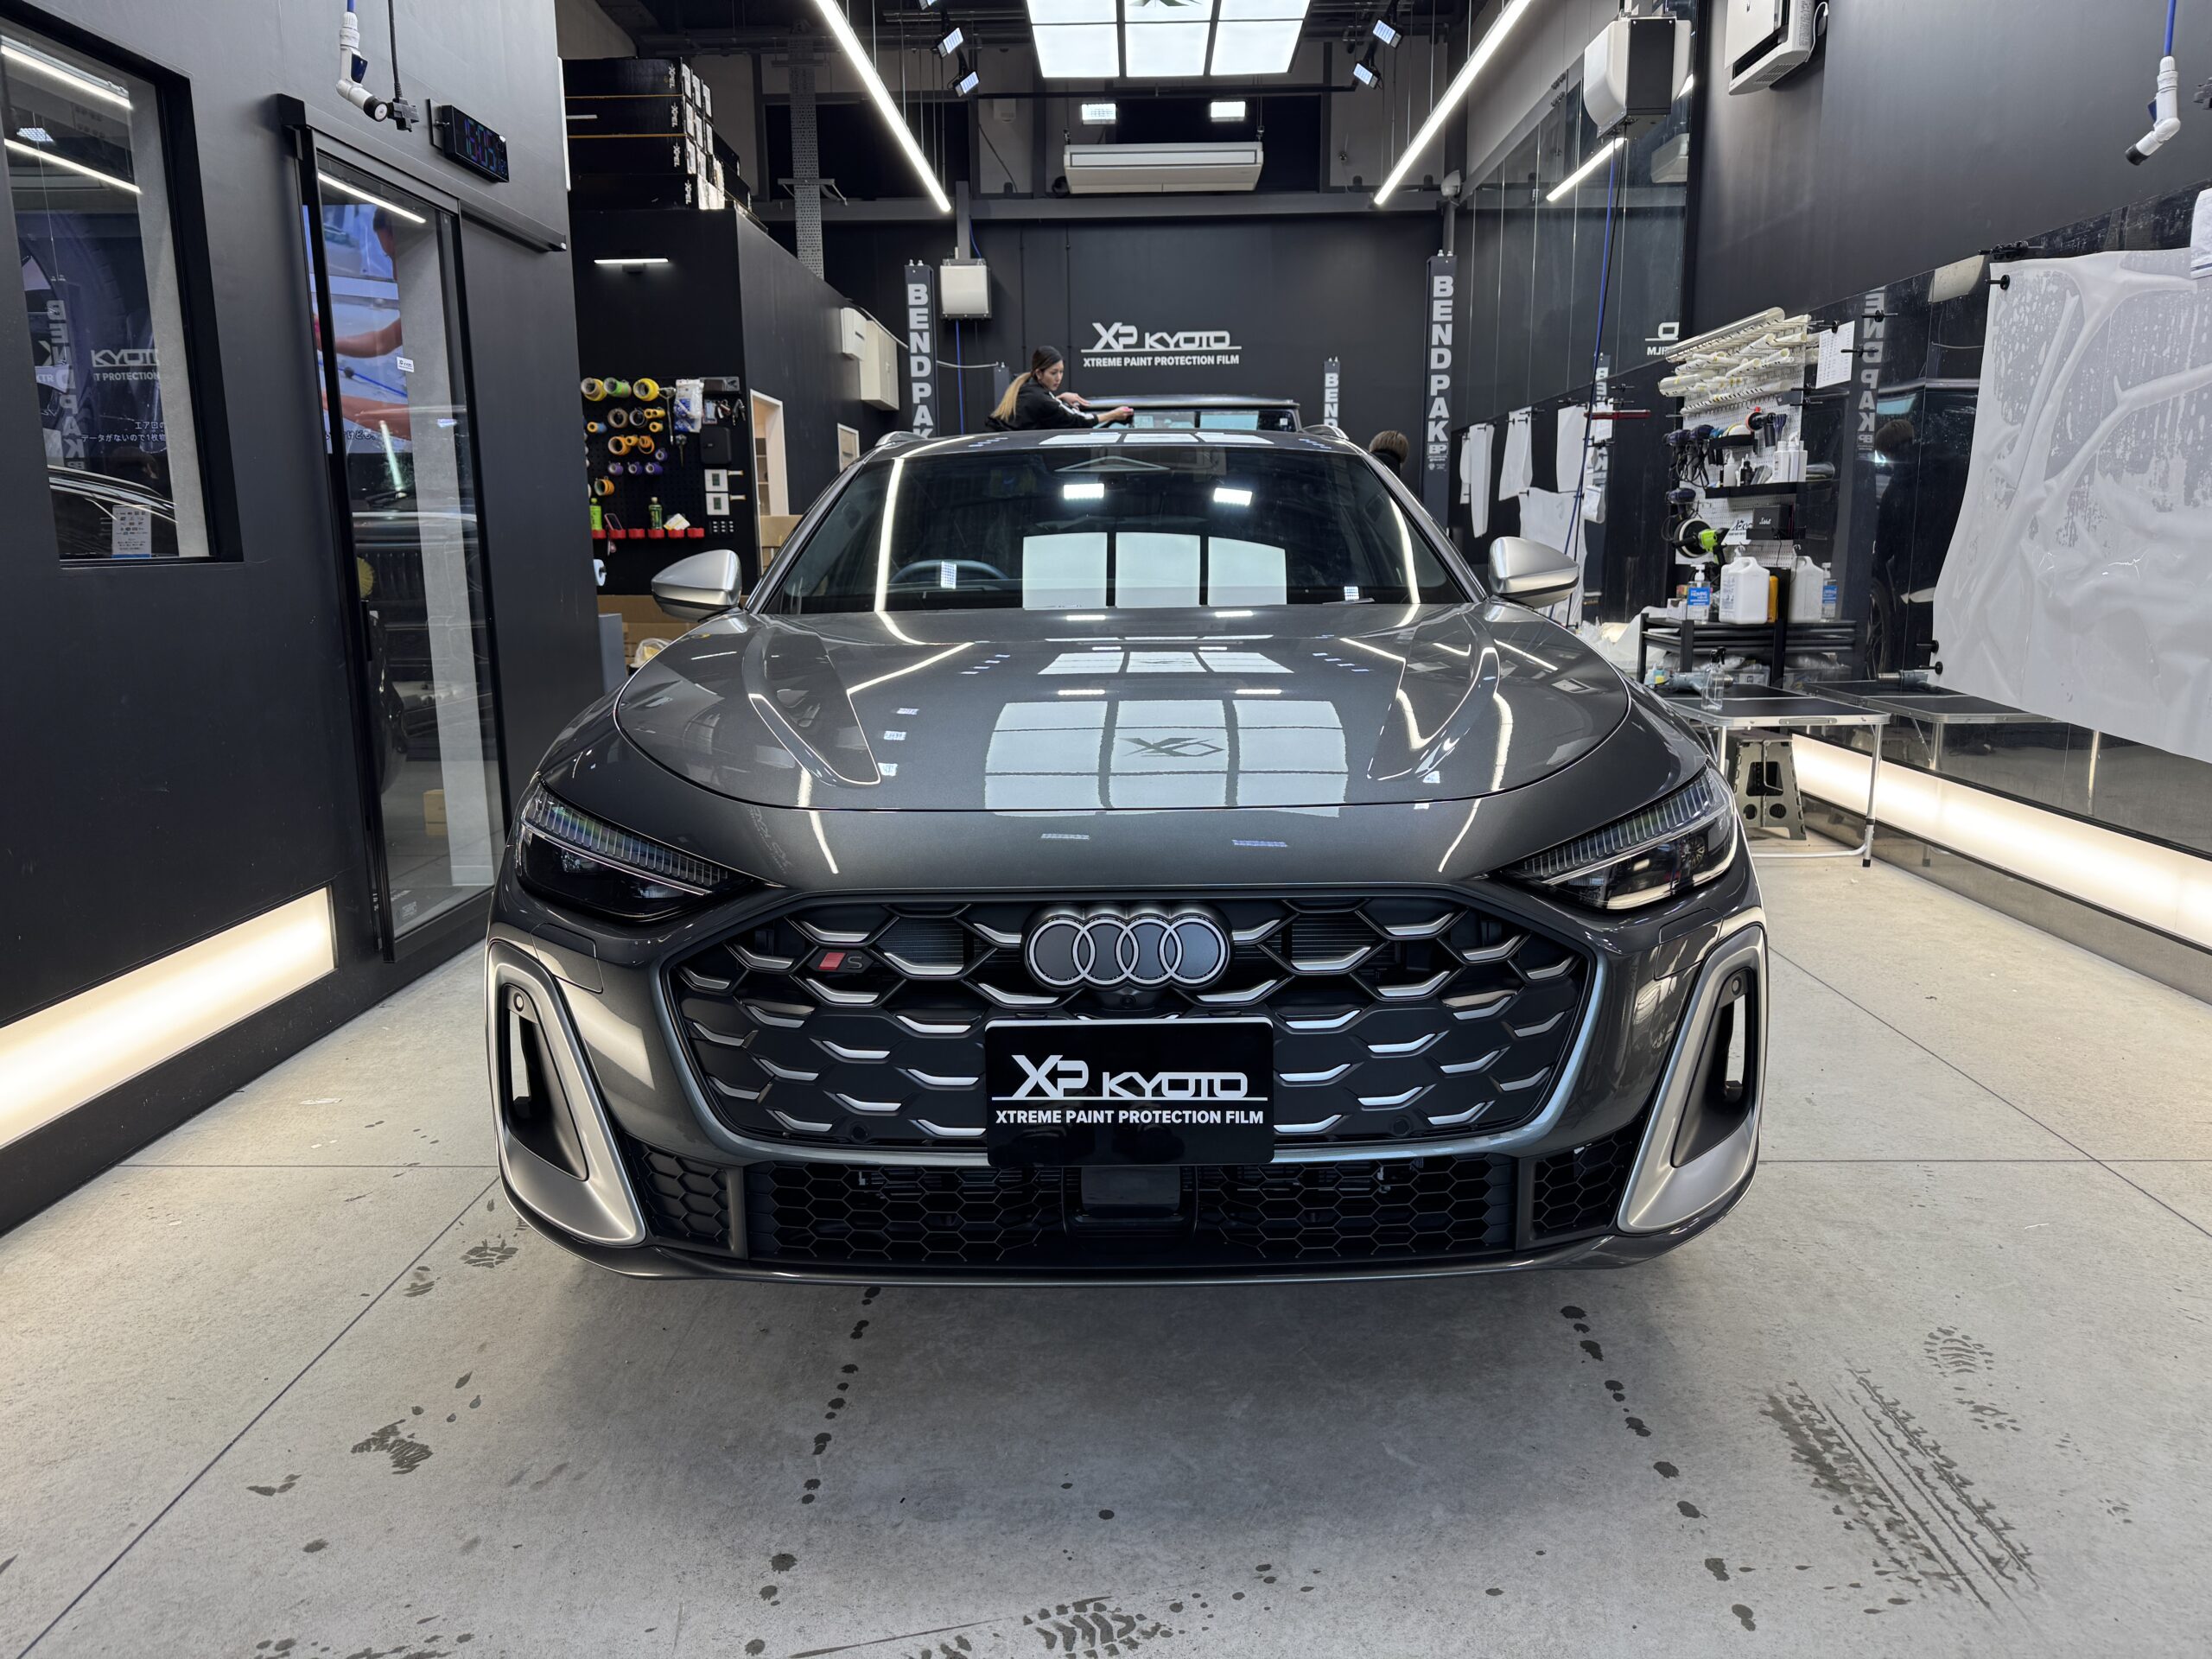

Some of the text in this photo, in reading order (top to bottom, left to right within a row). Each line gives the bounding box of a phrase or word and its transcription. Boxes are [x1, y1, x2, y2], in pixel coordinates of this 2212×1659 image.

[1092, 322, 1230, 349] XP KYOTO
[1084, 355, 1239, 367] XTREME PAINT PROTECTION FILM
[1427, 276, 1453, 442] BENDPAK
[847, 956, 863, 969] S
[1012, 1055, 1248, 1098] XP KYOTO
[995, 1109, 1264, 1123] XTREME PAINT PROTECTION FILM
